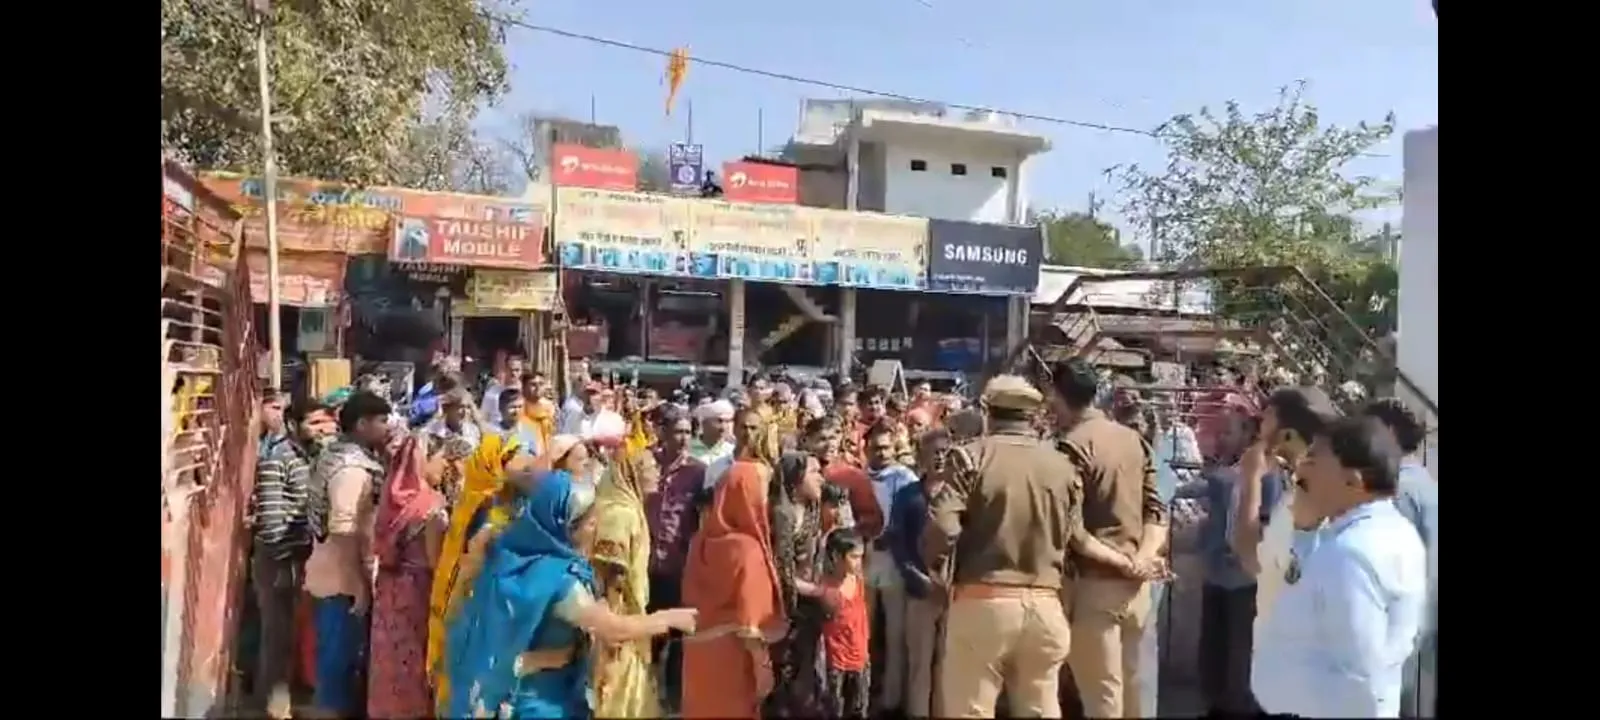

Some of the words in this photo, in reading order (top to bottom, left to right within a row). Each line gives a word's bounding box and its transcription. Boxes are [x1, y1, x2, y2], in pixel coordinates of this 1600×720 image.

[432, 219, 533, 241] TAUSHIF
[443, 239, 522, 258] MOBILE
[943, 243, 1028, 265] SAMSUNG
